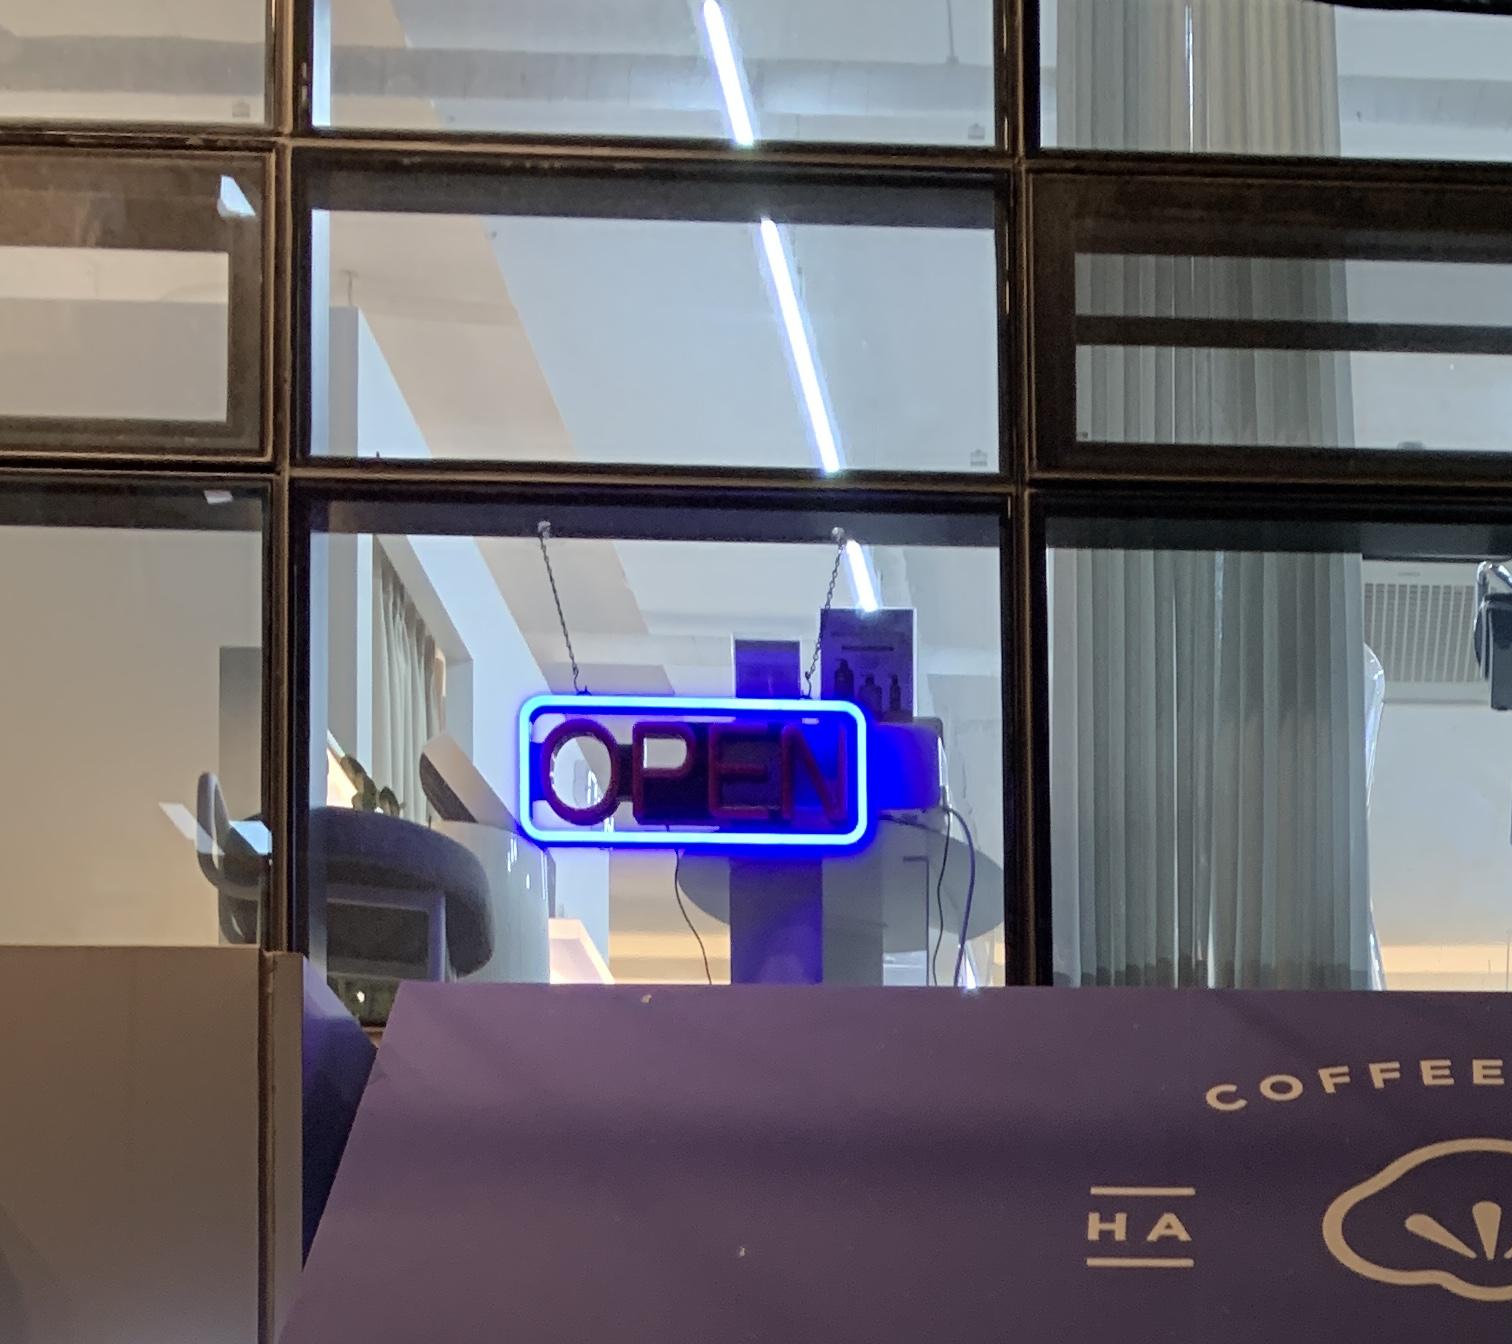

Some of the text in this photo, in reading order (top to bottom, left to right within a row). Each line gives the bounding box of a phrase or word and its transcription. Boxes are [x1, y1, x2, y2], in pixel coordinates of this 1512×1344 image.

[541, 718, 848, 826] OPEN
[1205, 1058, 1505, 1113] COFFEE
[1087, 1212, 1192, 1243] HA
